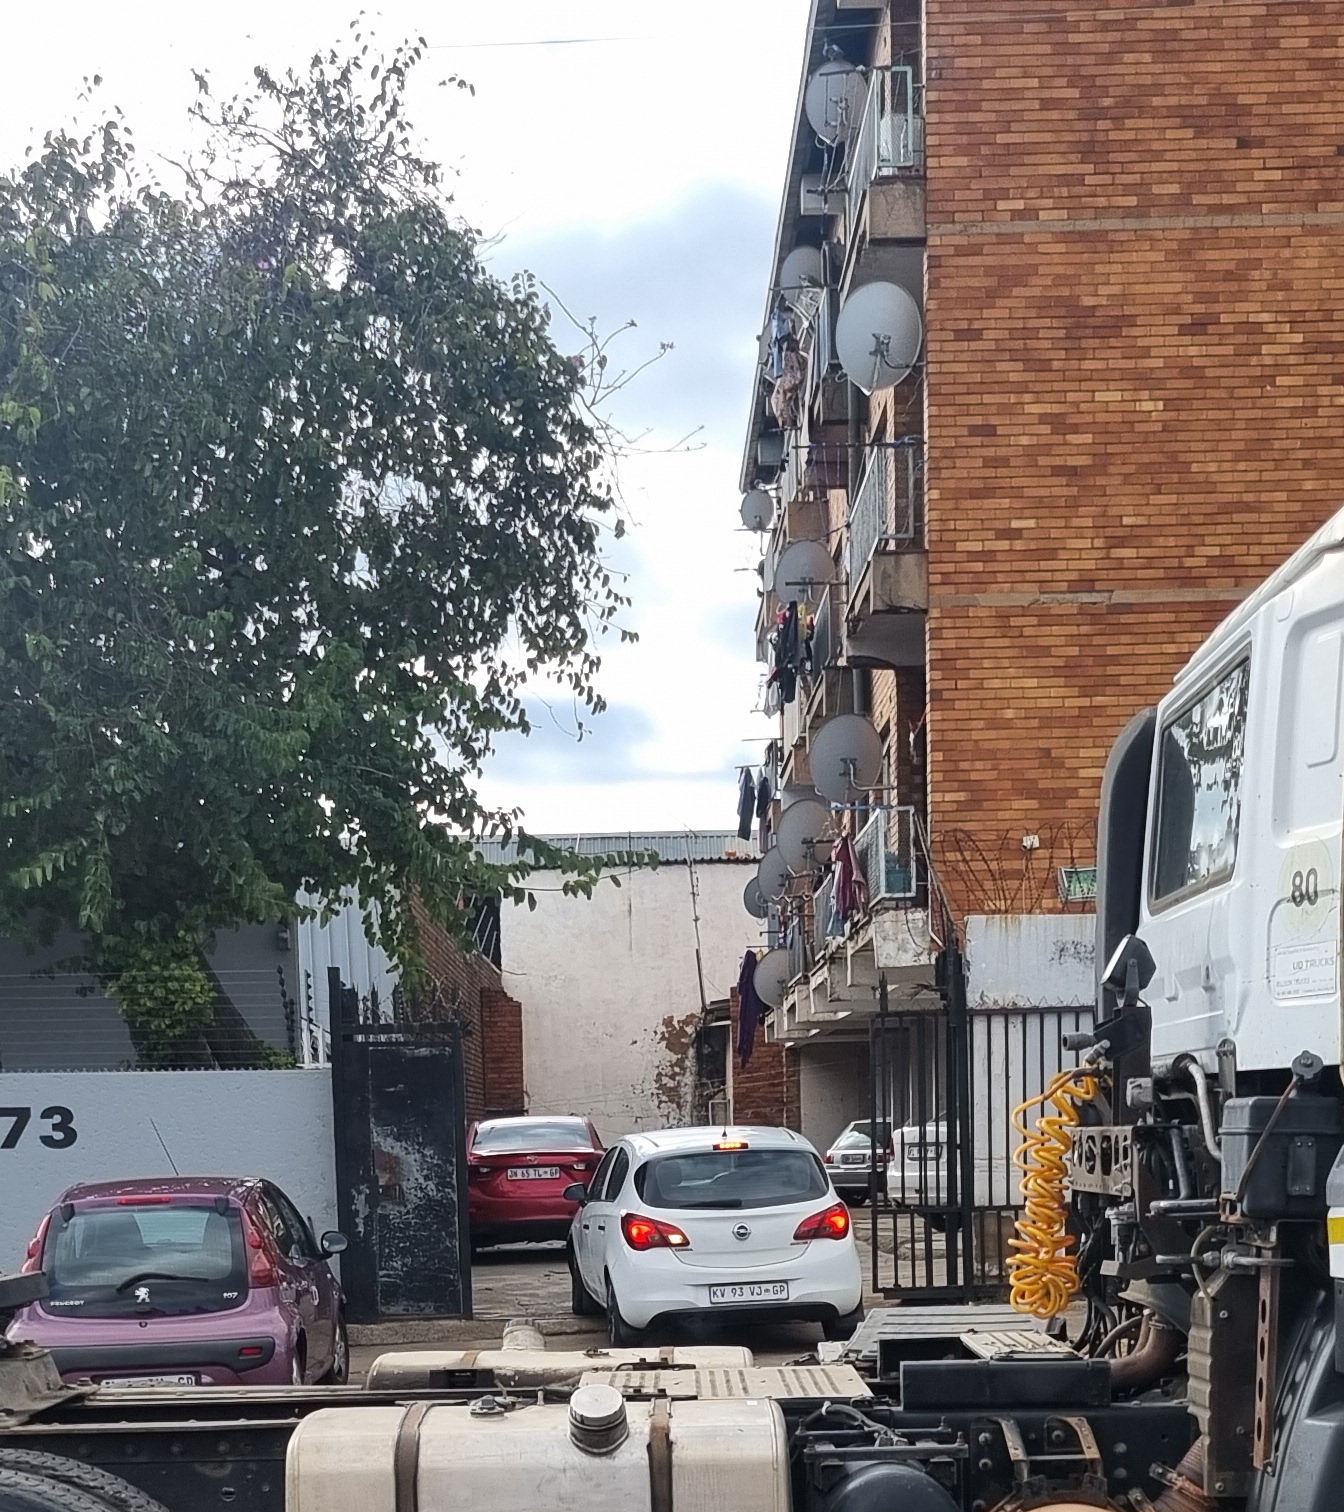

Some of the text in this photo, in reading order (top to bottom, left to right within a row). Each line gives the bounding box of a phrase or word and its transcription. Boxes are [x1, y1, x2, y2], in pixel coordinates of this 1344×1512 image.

[1291, 867, 1319, 907] 80
[1292, 957, 1335, 970] UD TRUCKS
[712, 1284, 785, 1298] KV 93 VJ GP
